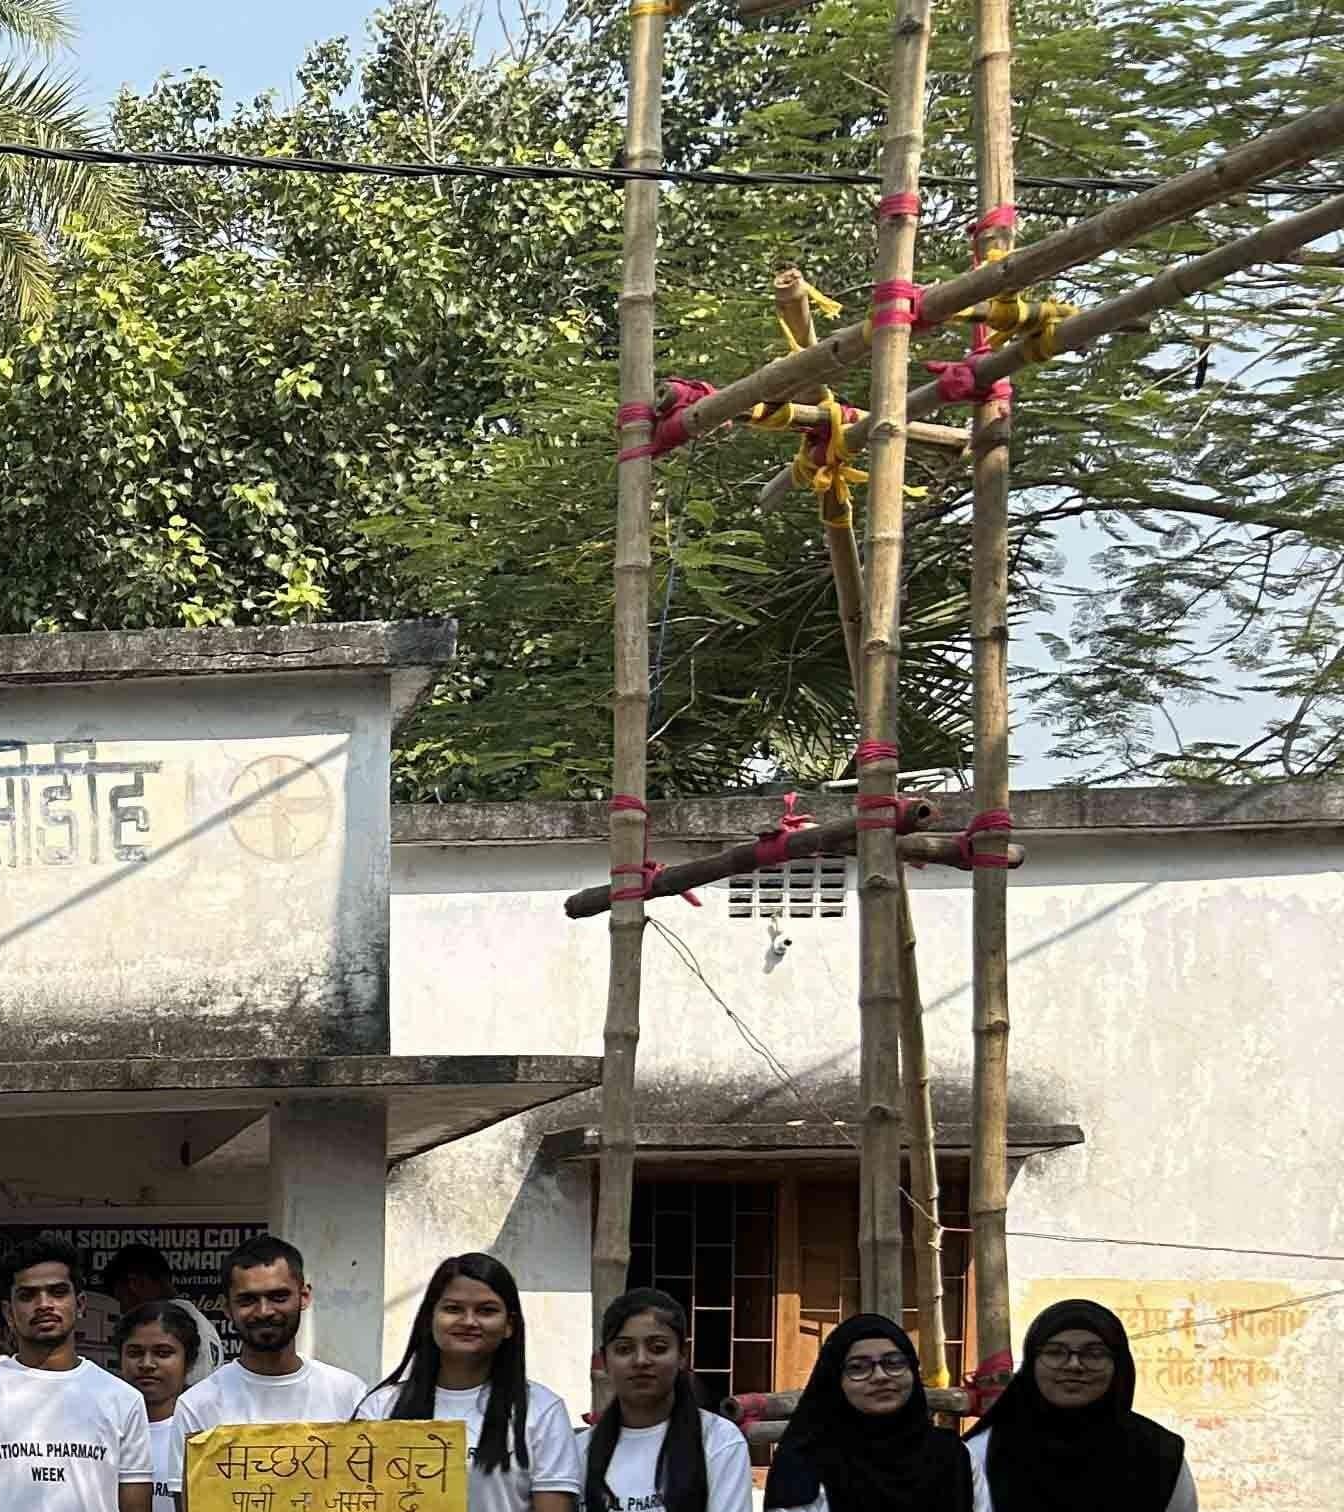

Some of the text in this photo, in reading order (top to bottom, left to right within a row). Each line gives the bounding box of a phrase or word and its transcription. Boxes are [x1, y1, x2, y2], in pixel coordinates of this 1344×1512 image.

[46, 1442, 107, 1462] PHARMACY
[346, 1433, 377, 1483] से
[31, 1464, 66, 1483] WEEK
[324, 1485, 385, 1512] जमने
